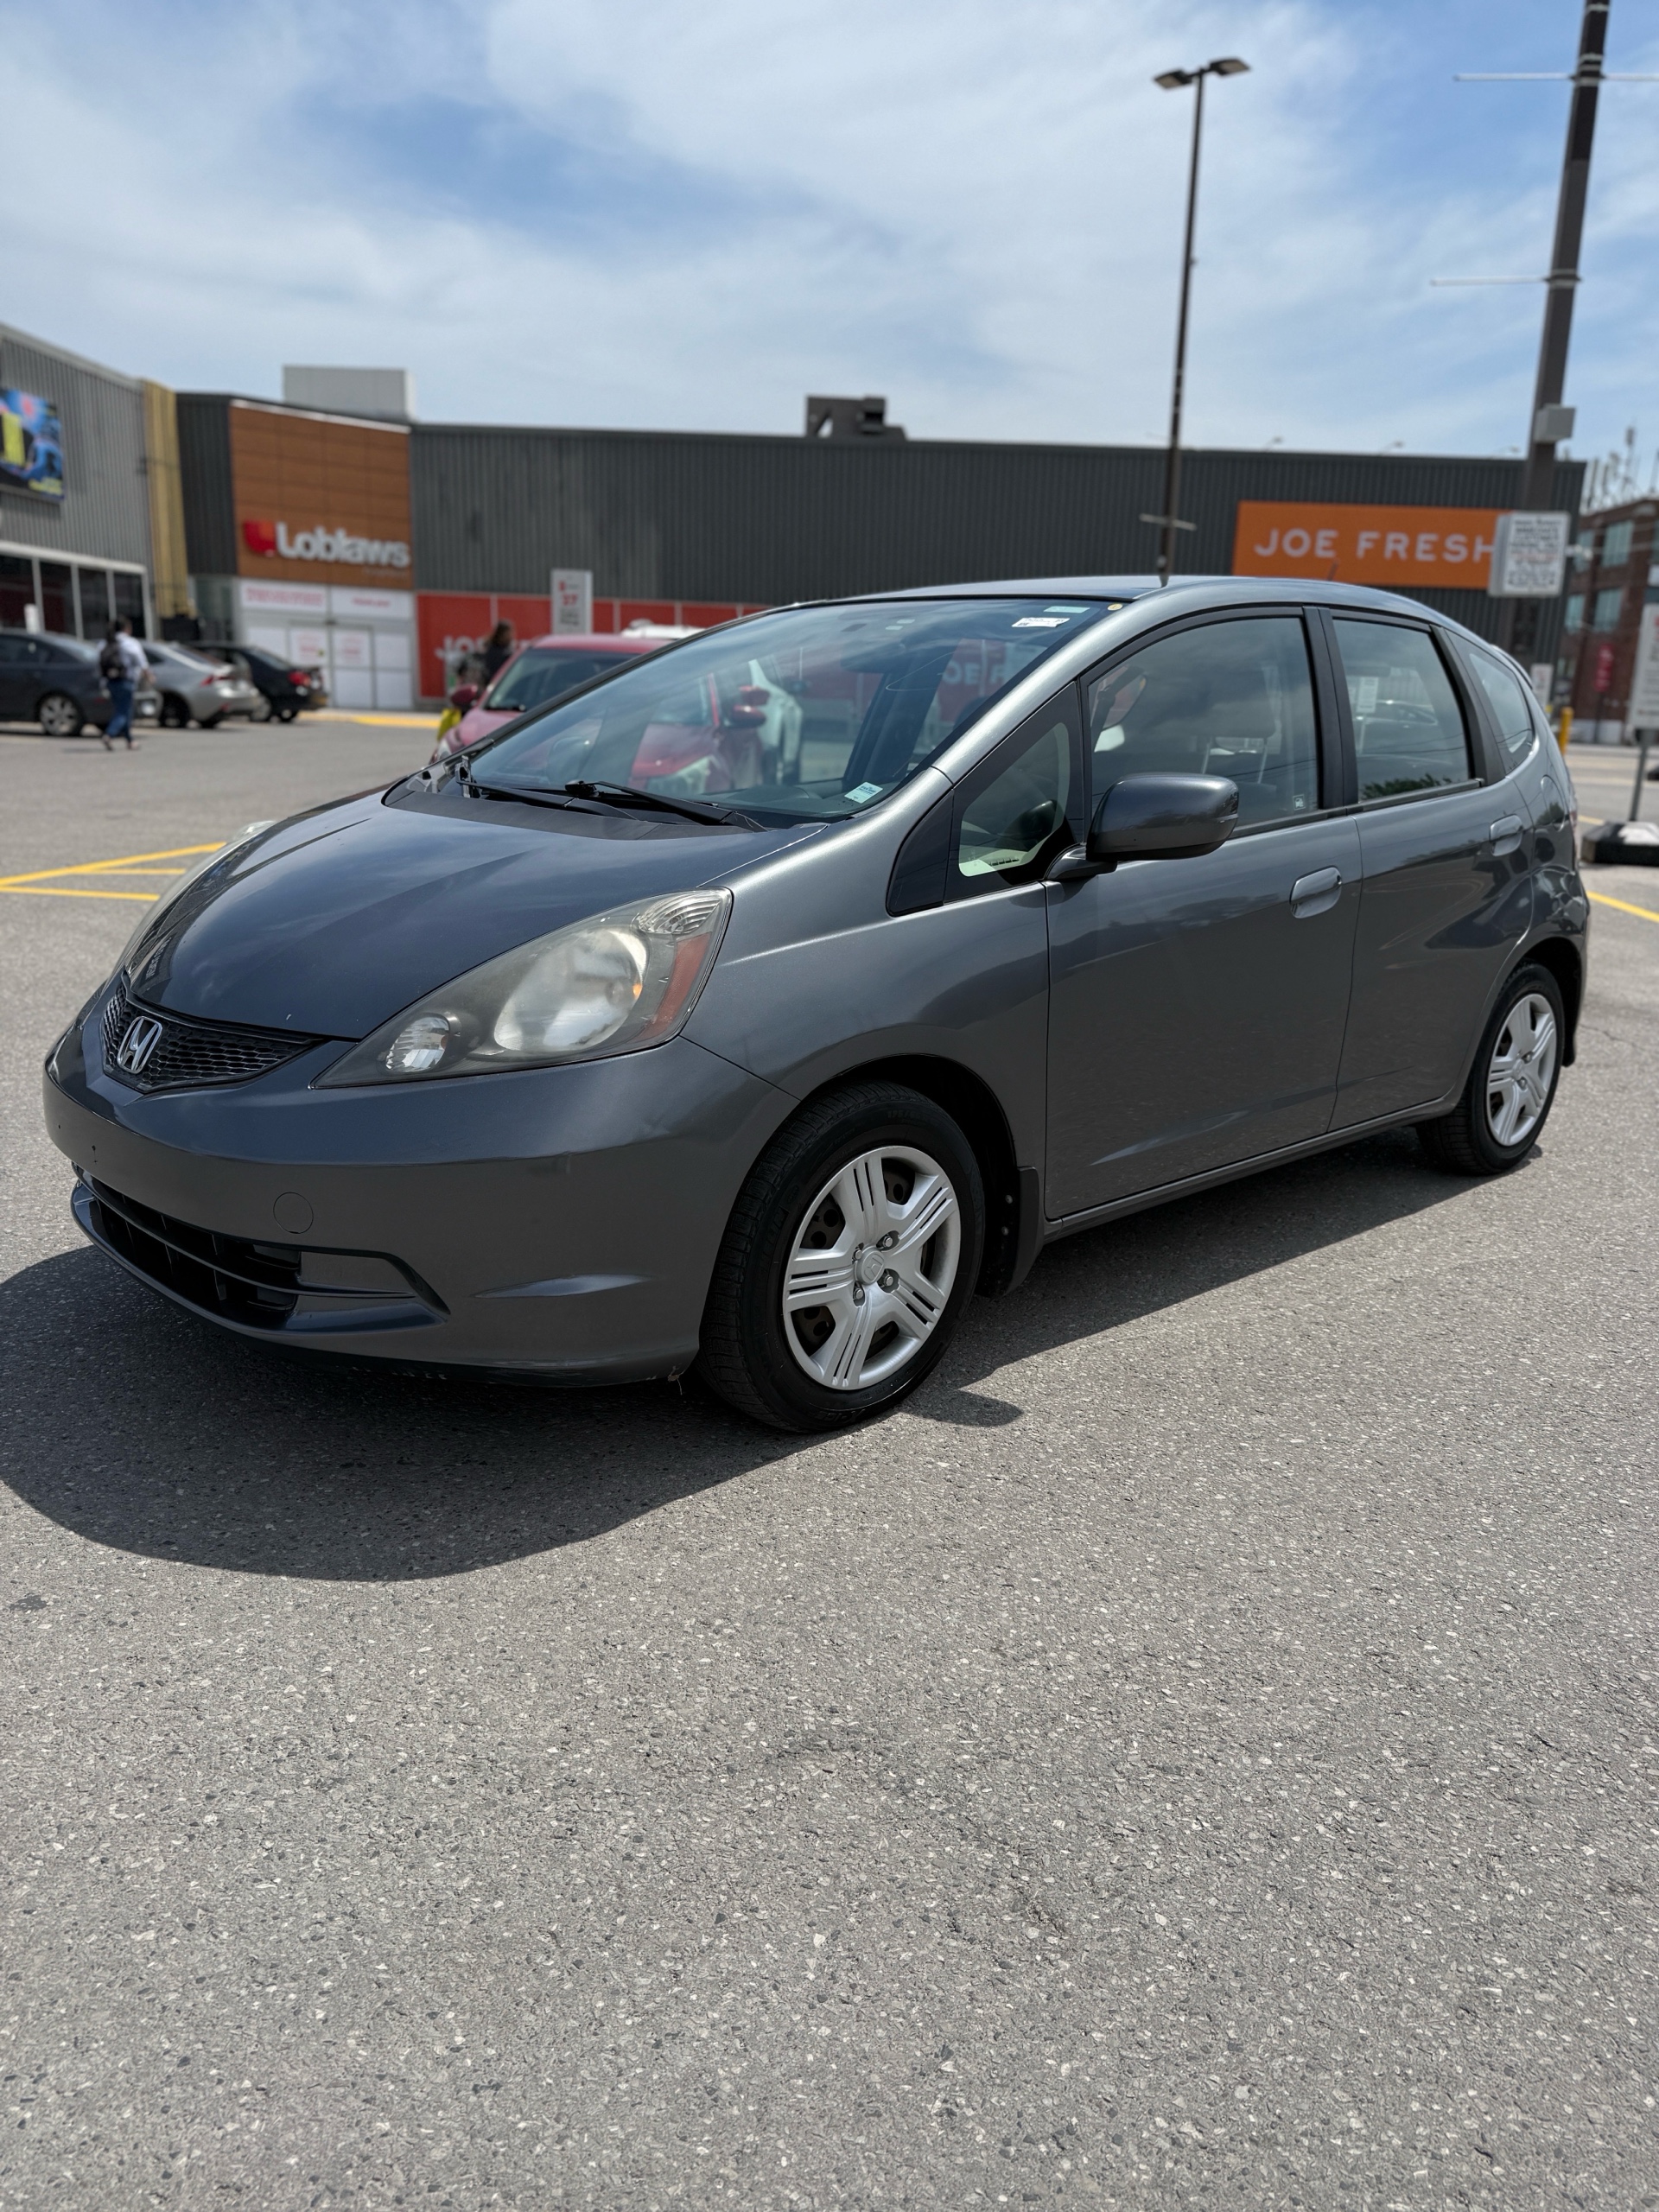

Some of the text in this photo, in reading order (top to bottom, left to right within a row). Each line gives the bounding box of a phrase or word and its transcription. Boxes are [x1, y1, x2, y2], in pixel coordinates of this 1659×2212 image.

[275, 521, 410, 568] Loblaws
[1254, 528, 1338, 557] JOE
[1357, 531, 1495, 563] FRESH
